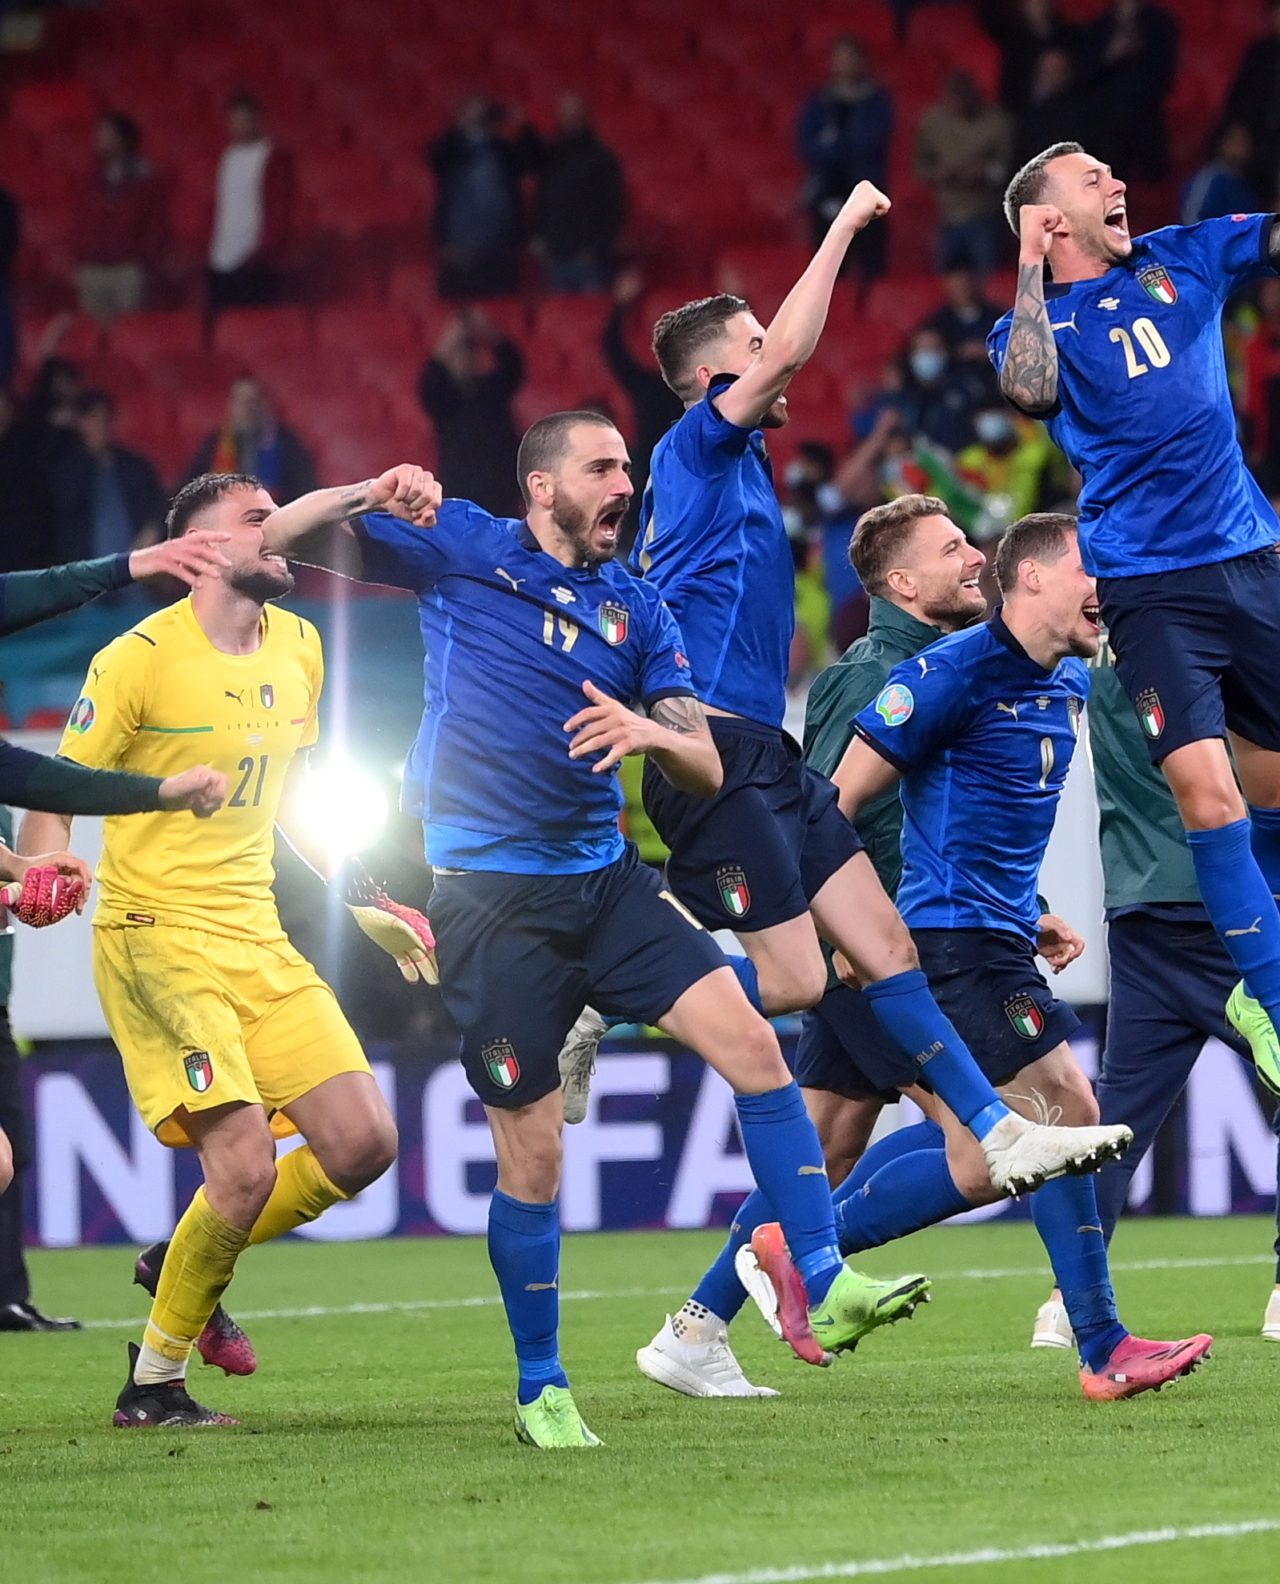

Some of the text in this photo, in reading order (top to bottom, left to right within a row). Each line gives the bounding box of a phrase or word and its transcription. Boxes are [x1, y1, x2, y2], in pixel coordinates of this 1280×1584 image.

[1108, 317, 1171, 378] 20
[227, 721, 279, 731] ITALIA
[227, 754, 269, 808] 21
[719, 875, 744, 887] ITALIA
[1008, 1000, 1032, 1016] ITALIA
[185, 1052, 209, 1066] ITALIA
[485, 1047, 511, 1060] ITALIA
